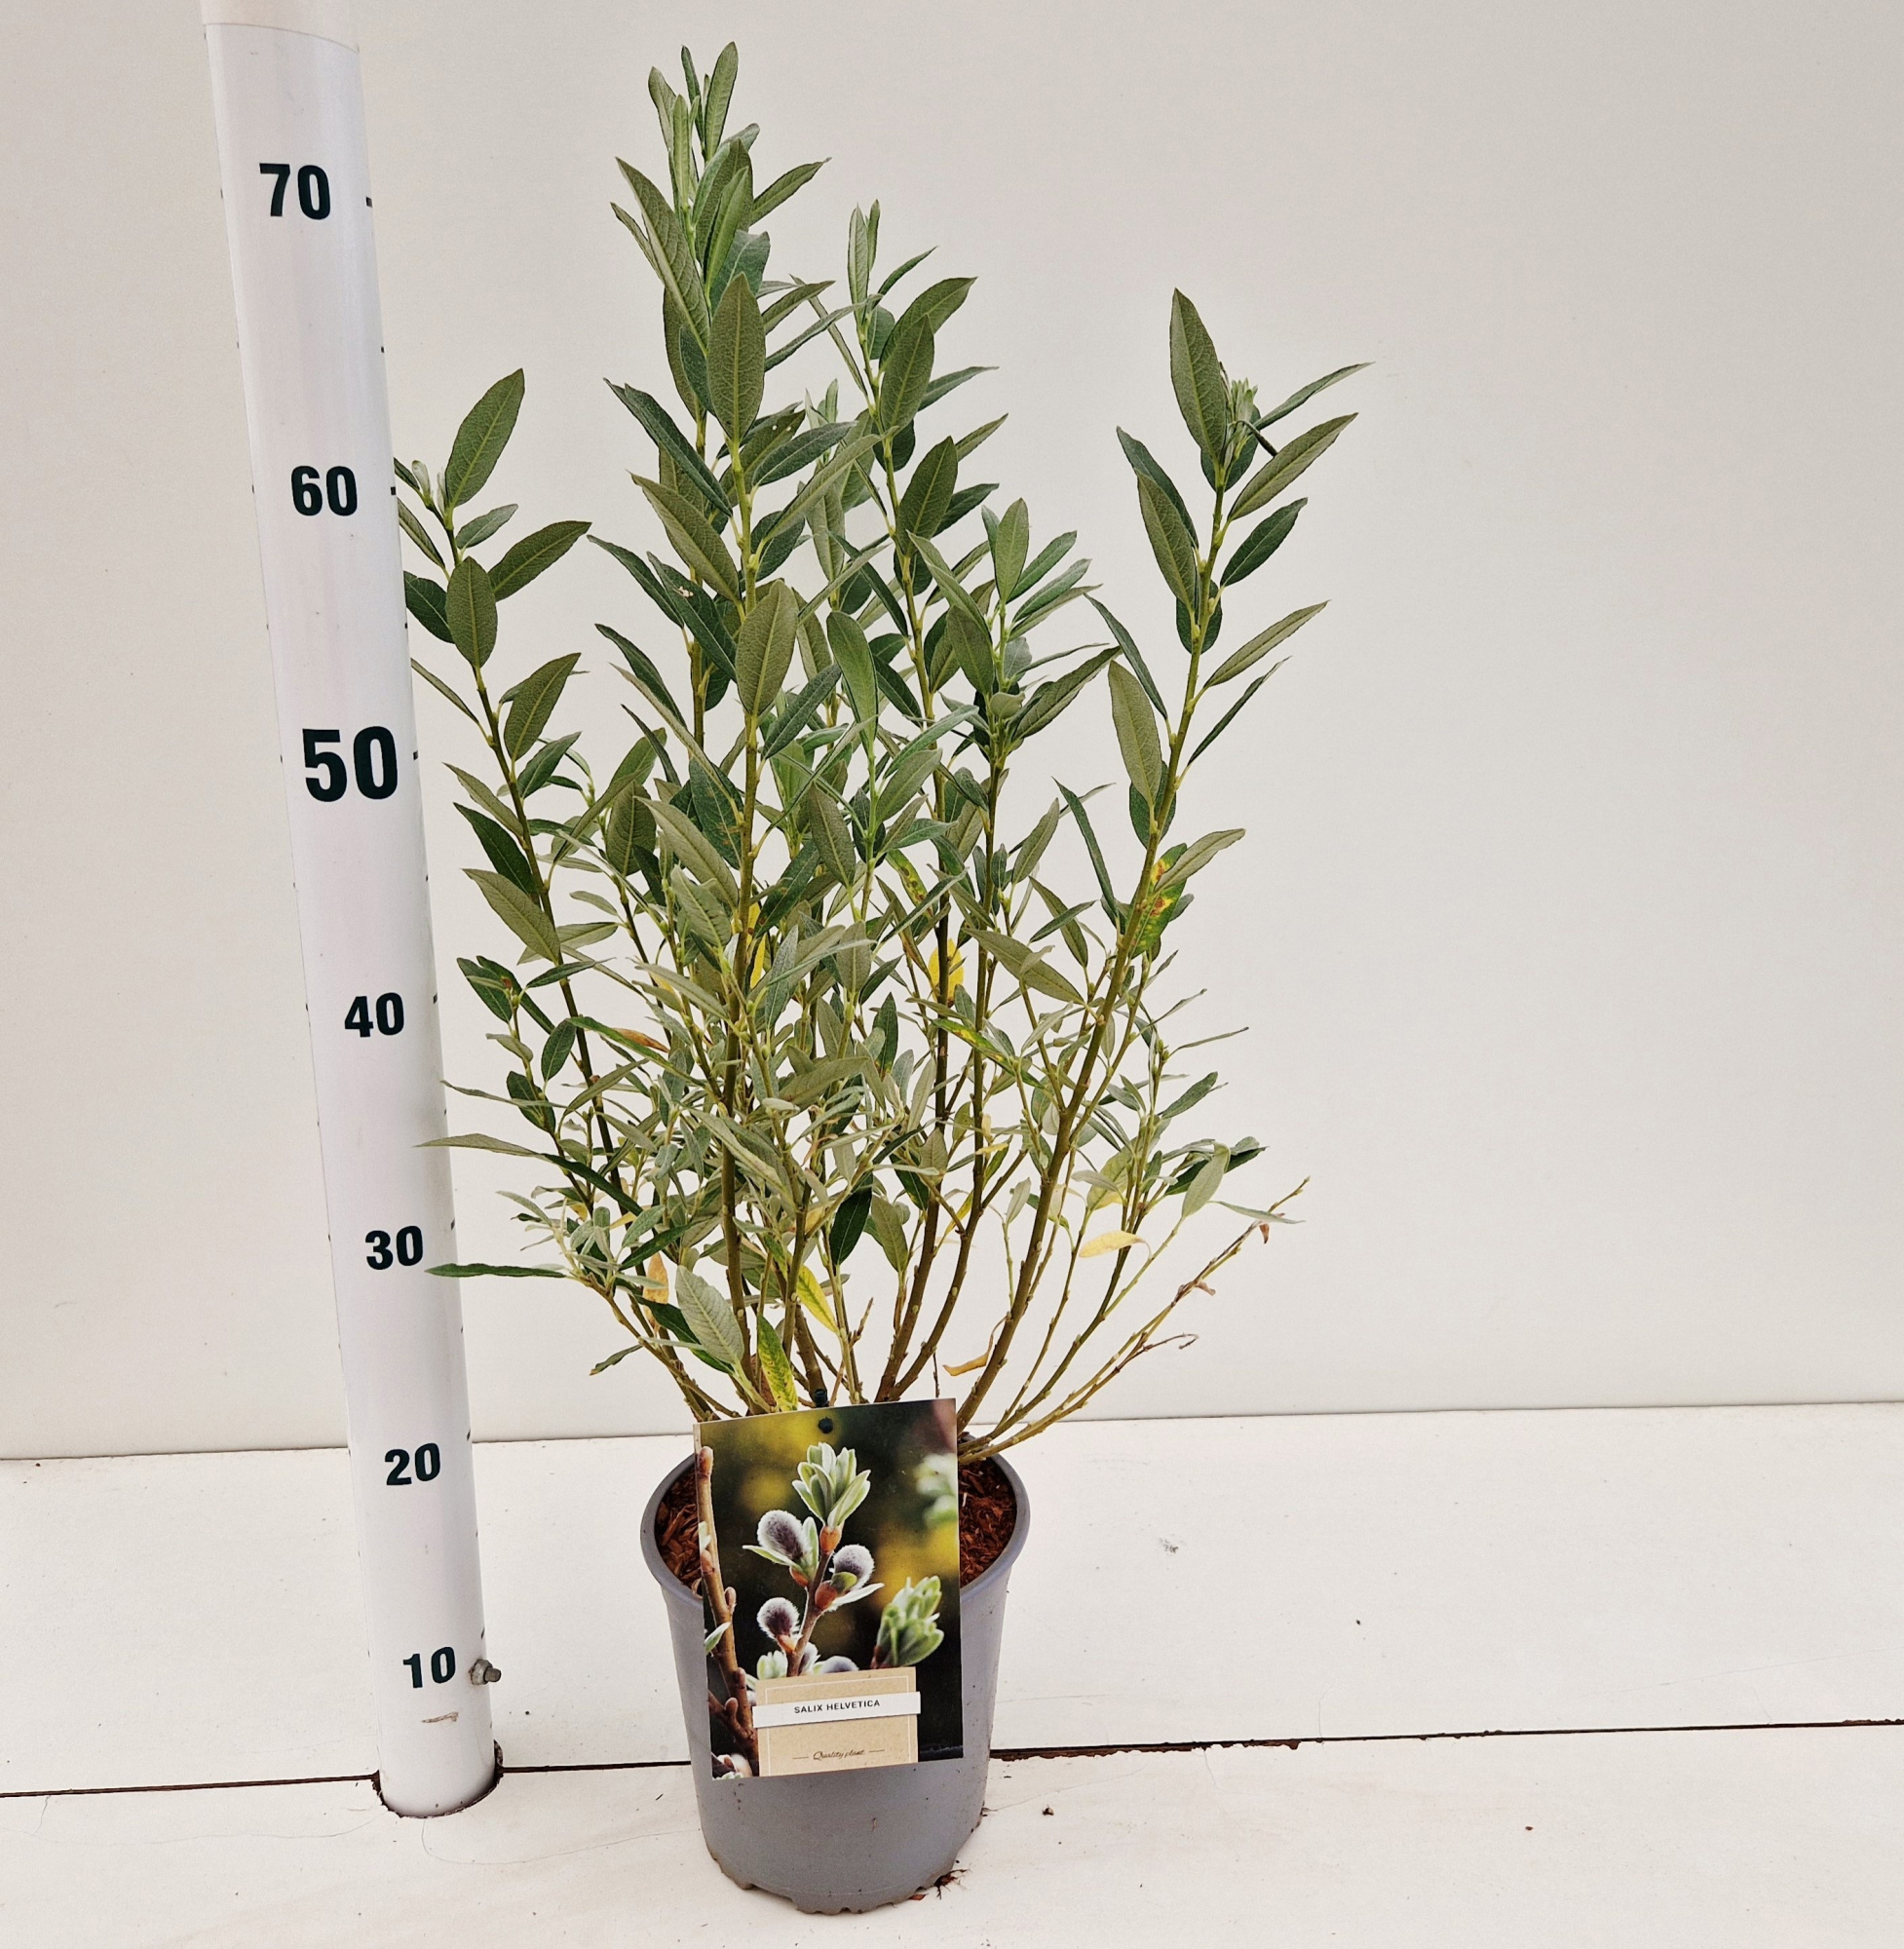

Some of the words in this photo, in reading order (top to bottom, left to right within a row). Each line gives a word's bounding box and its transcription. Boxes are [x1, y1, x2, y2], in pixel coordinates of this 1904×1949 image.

[258, 162, 331, 221] 70
[290, 465, 358, 516] 60
[302, 725, 399, 803] 50
[344, 992, 404, 1038] 40
[364, 1225, 424, 1271] 30
[384, 1442, 441, 1486] 20
[402, 1646, 456, 1689] 10
[794, 1704, 823, 1714] SALIX
[826, 1700, 880, 1710] HELVETICA
[813, 1751, 844, 1760] Quality
[844, 1749, 864, 1758] plant
